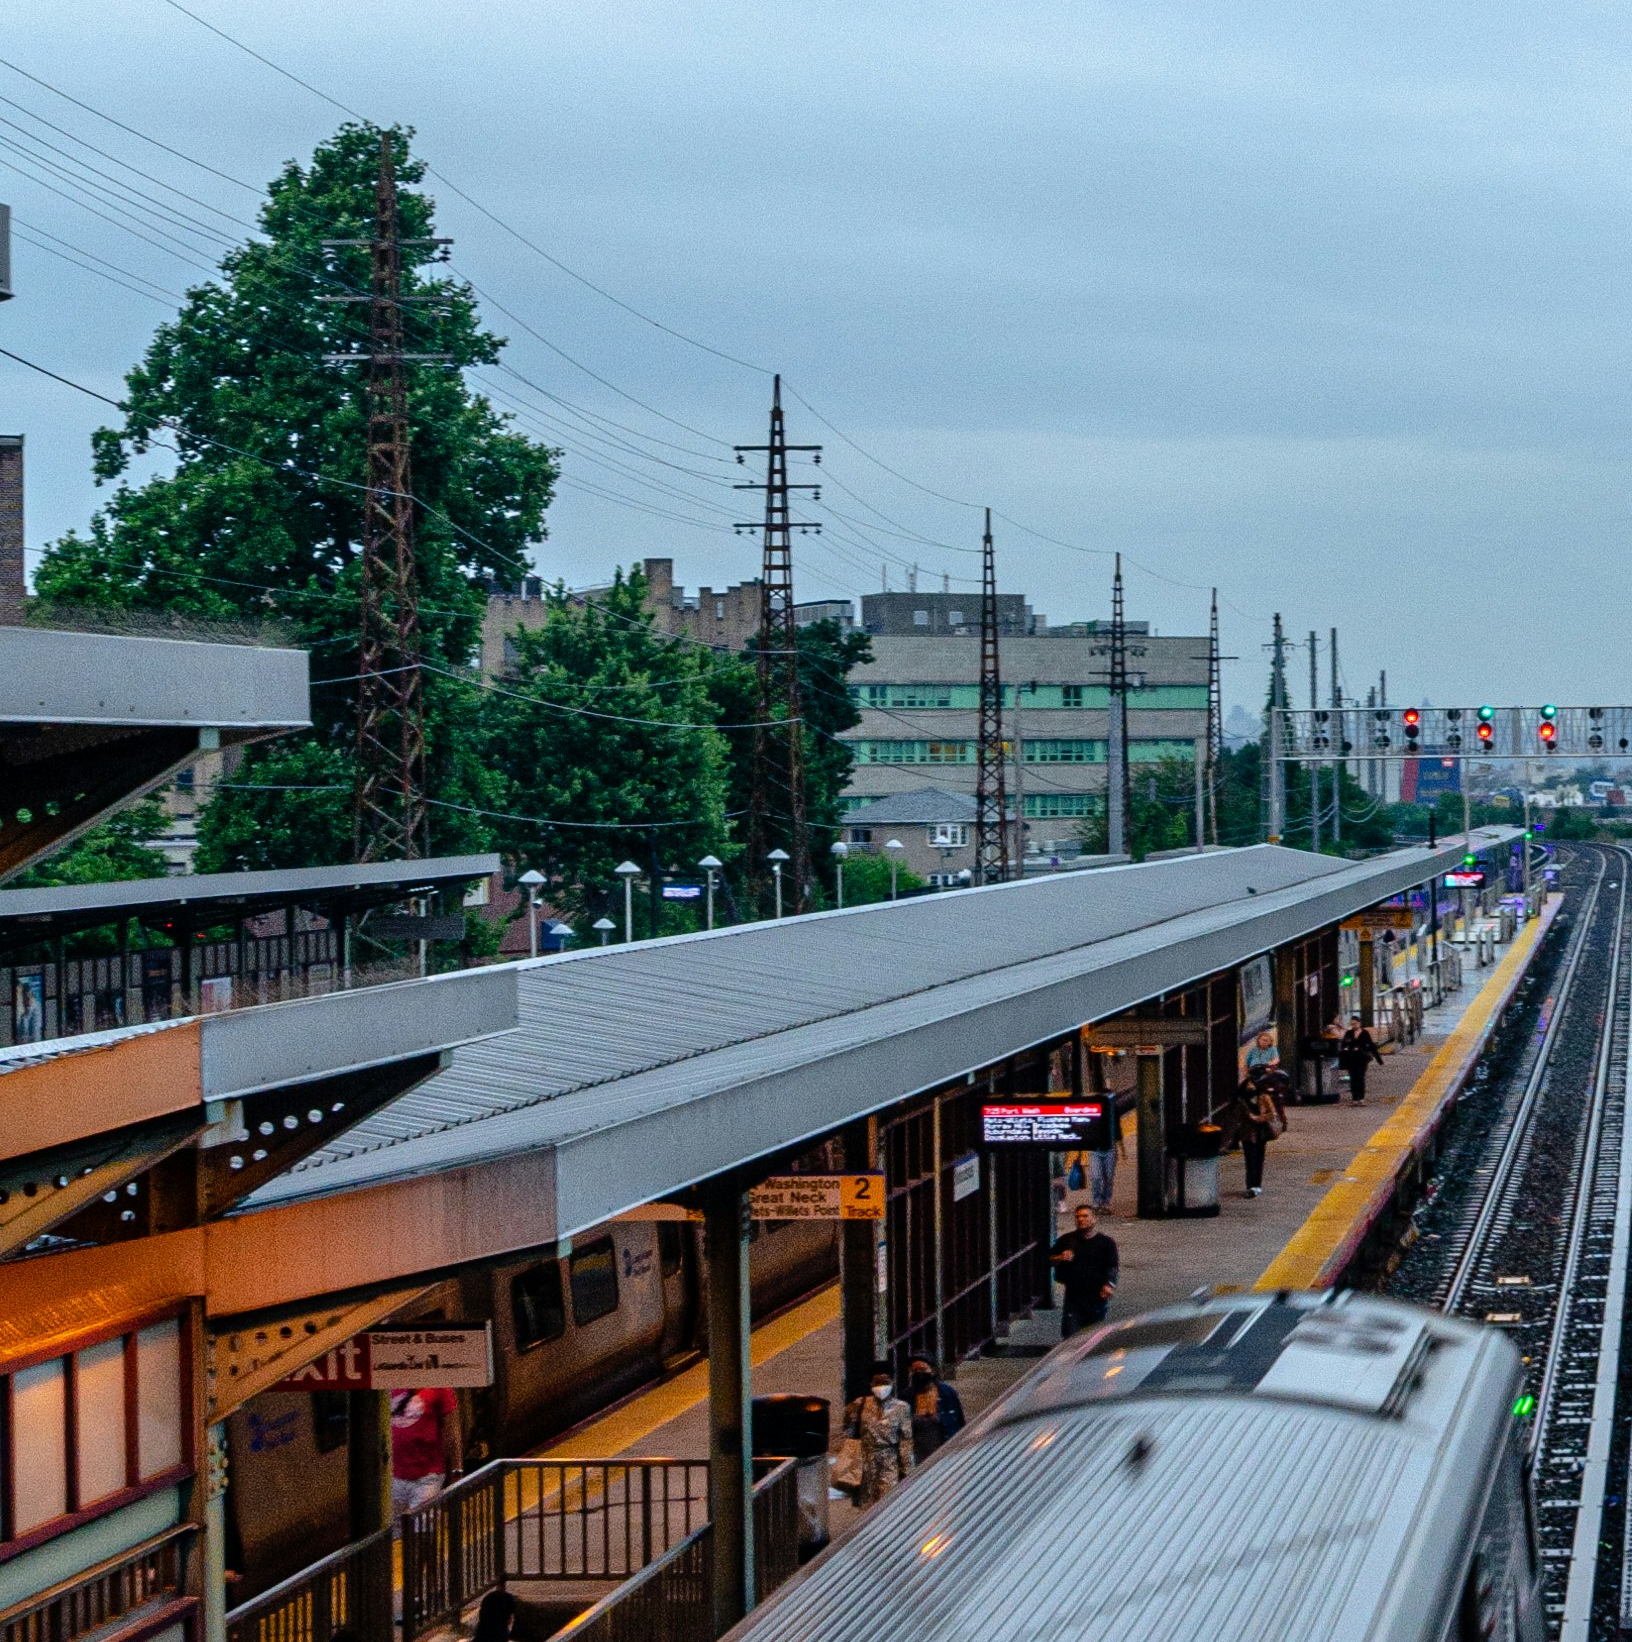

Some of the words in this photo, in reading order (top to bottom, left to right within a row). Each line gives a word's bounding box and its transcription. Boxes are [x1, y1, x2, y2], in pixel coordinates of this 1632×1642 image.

[854, 1177, 871, 1200] 2
[790, 1191, 827, 1204] Neck
[751, 1206, 809, 1217] ets-Willets
[813, 1204, 840, 1216] Point
[844, 1205, 881, 1217] Track
[371, 1334, 411, 1345] Street
[424, 1333, 466, 1344] Buses
